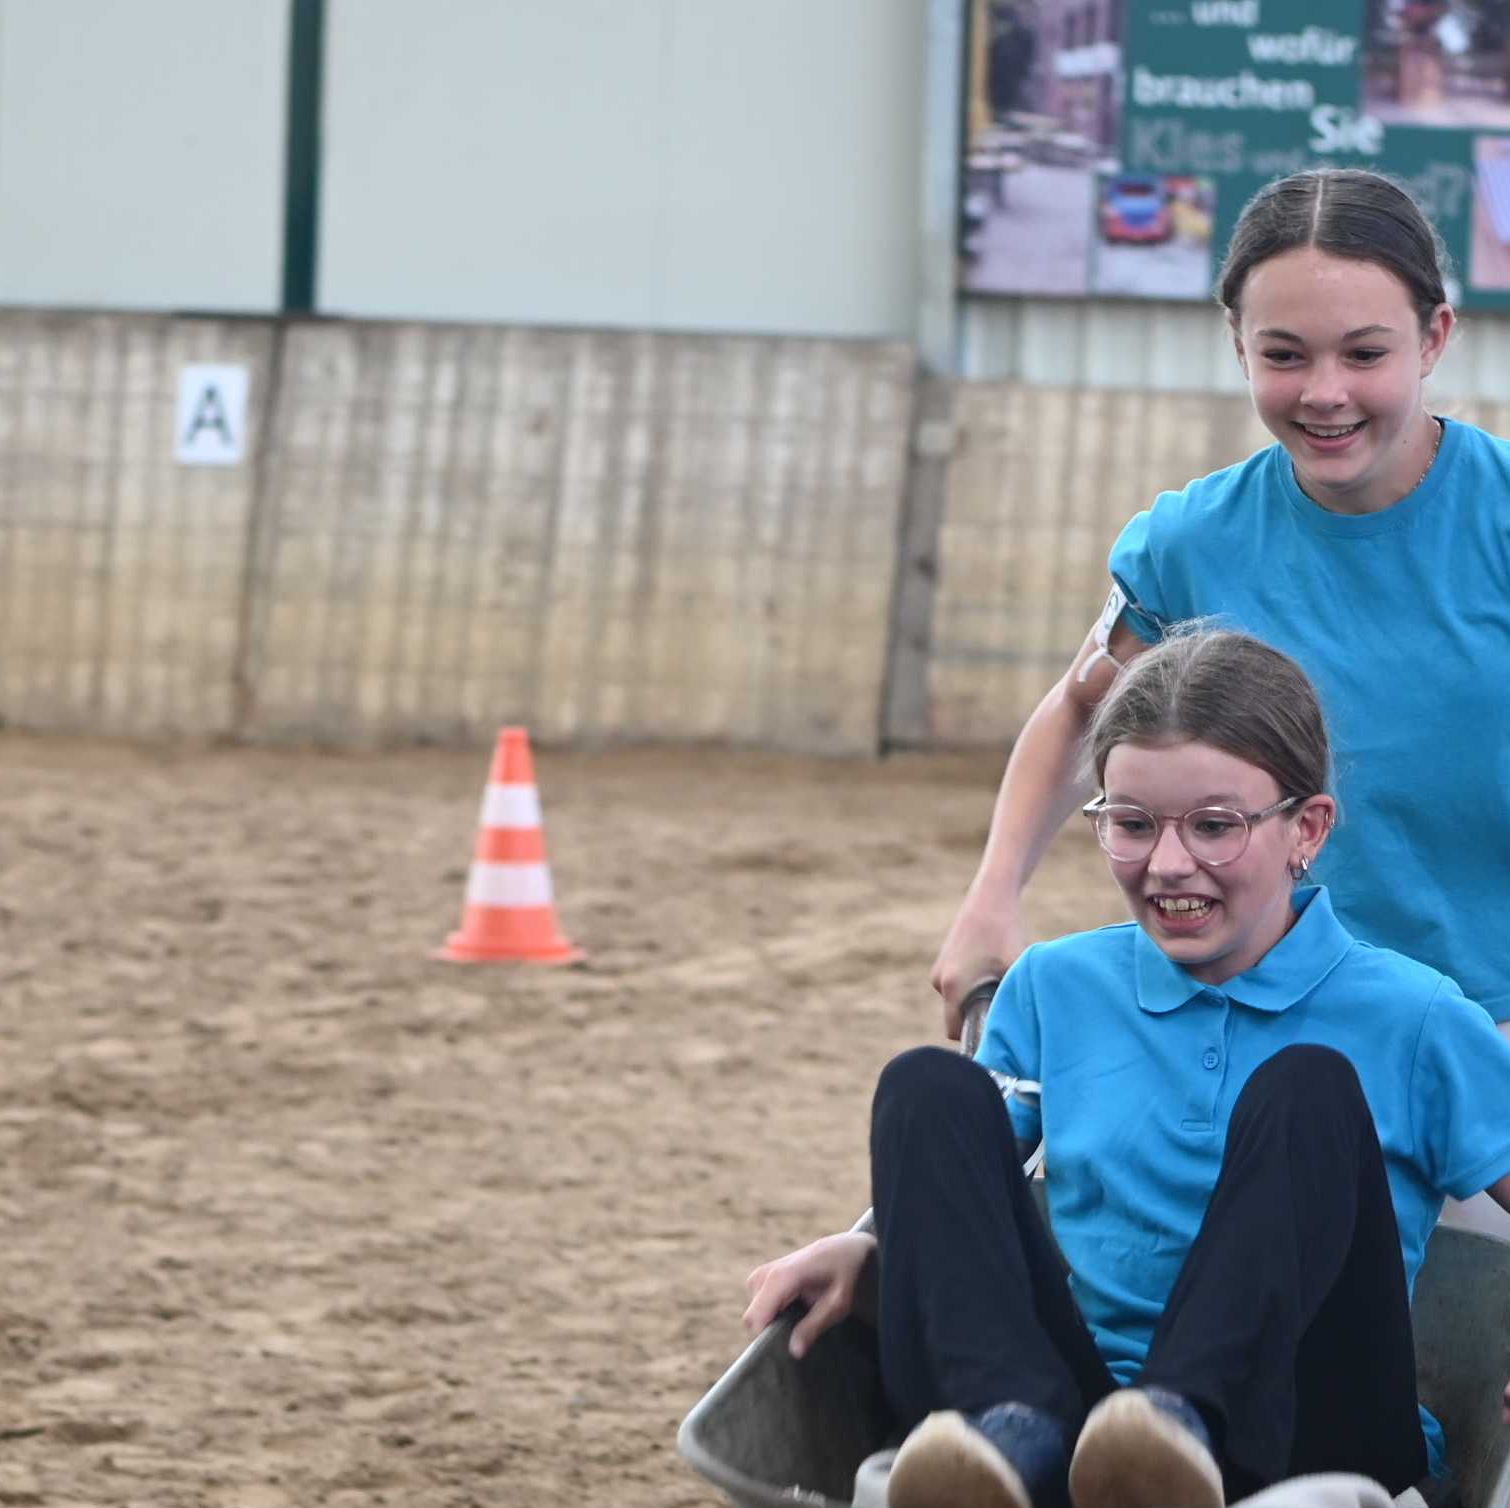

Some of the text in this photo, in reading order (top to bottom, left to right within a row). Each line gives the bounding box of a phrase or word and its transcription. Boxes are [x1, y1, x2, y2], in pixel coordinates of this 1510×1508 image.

[1133, 63, 1314, 110] brauchen
[1309, 103, 1384, 155] Sie
[183, 384, 235, 447] A
